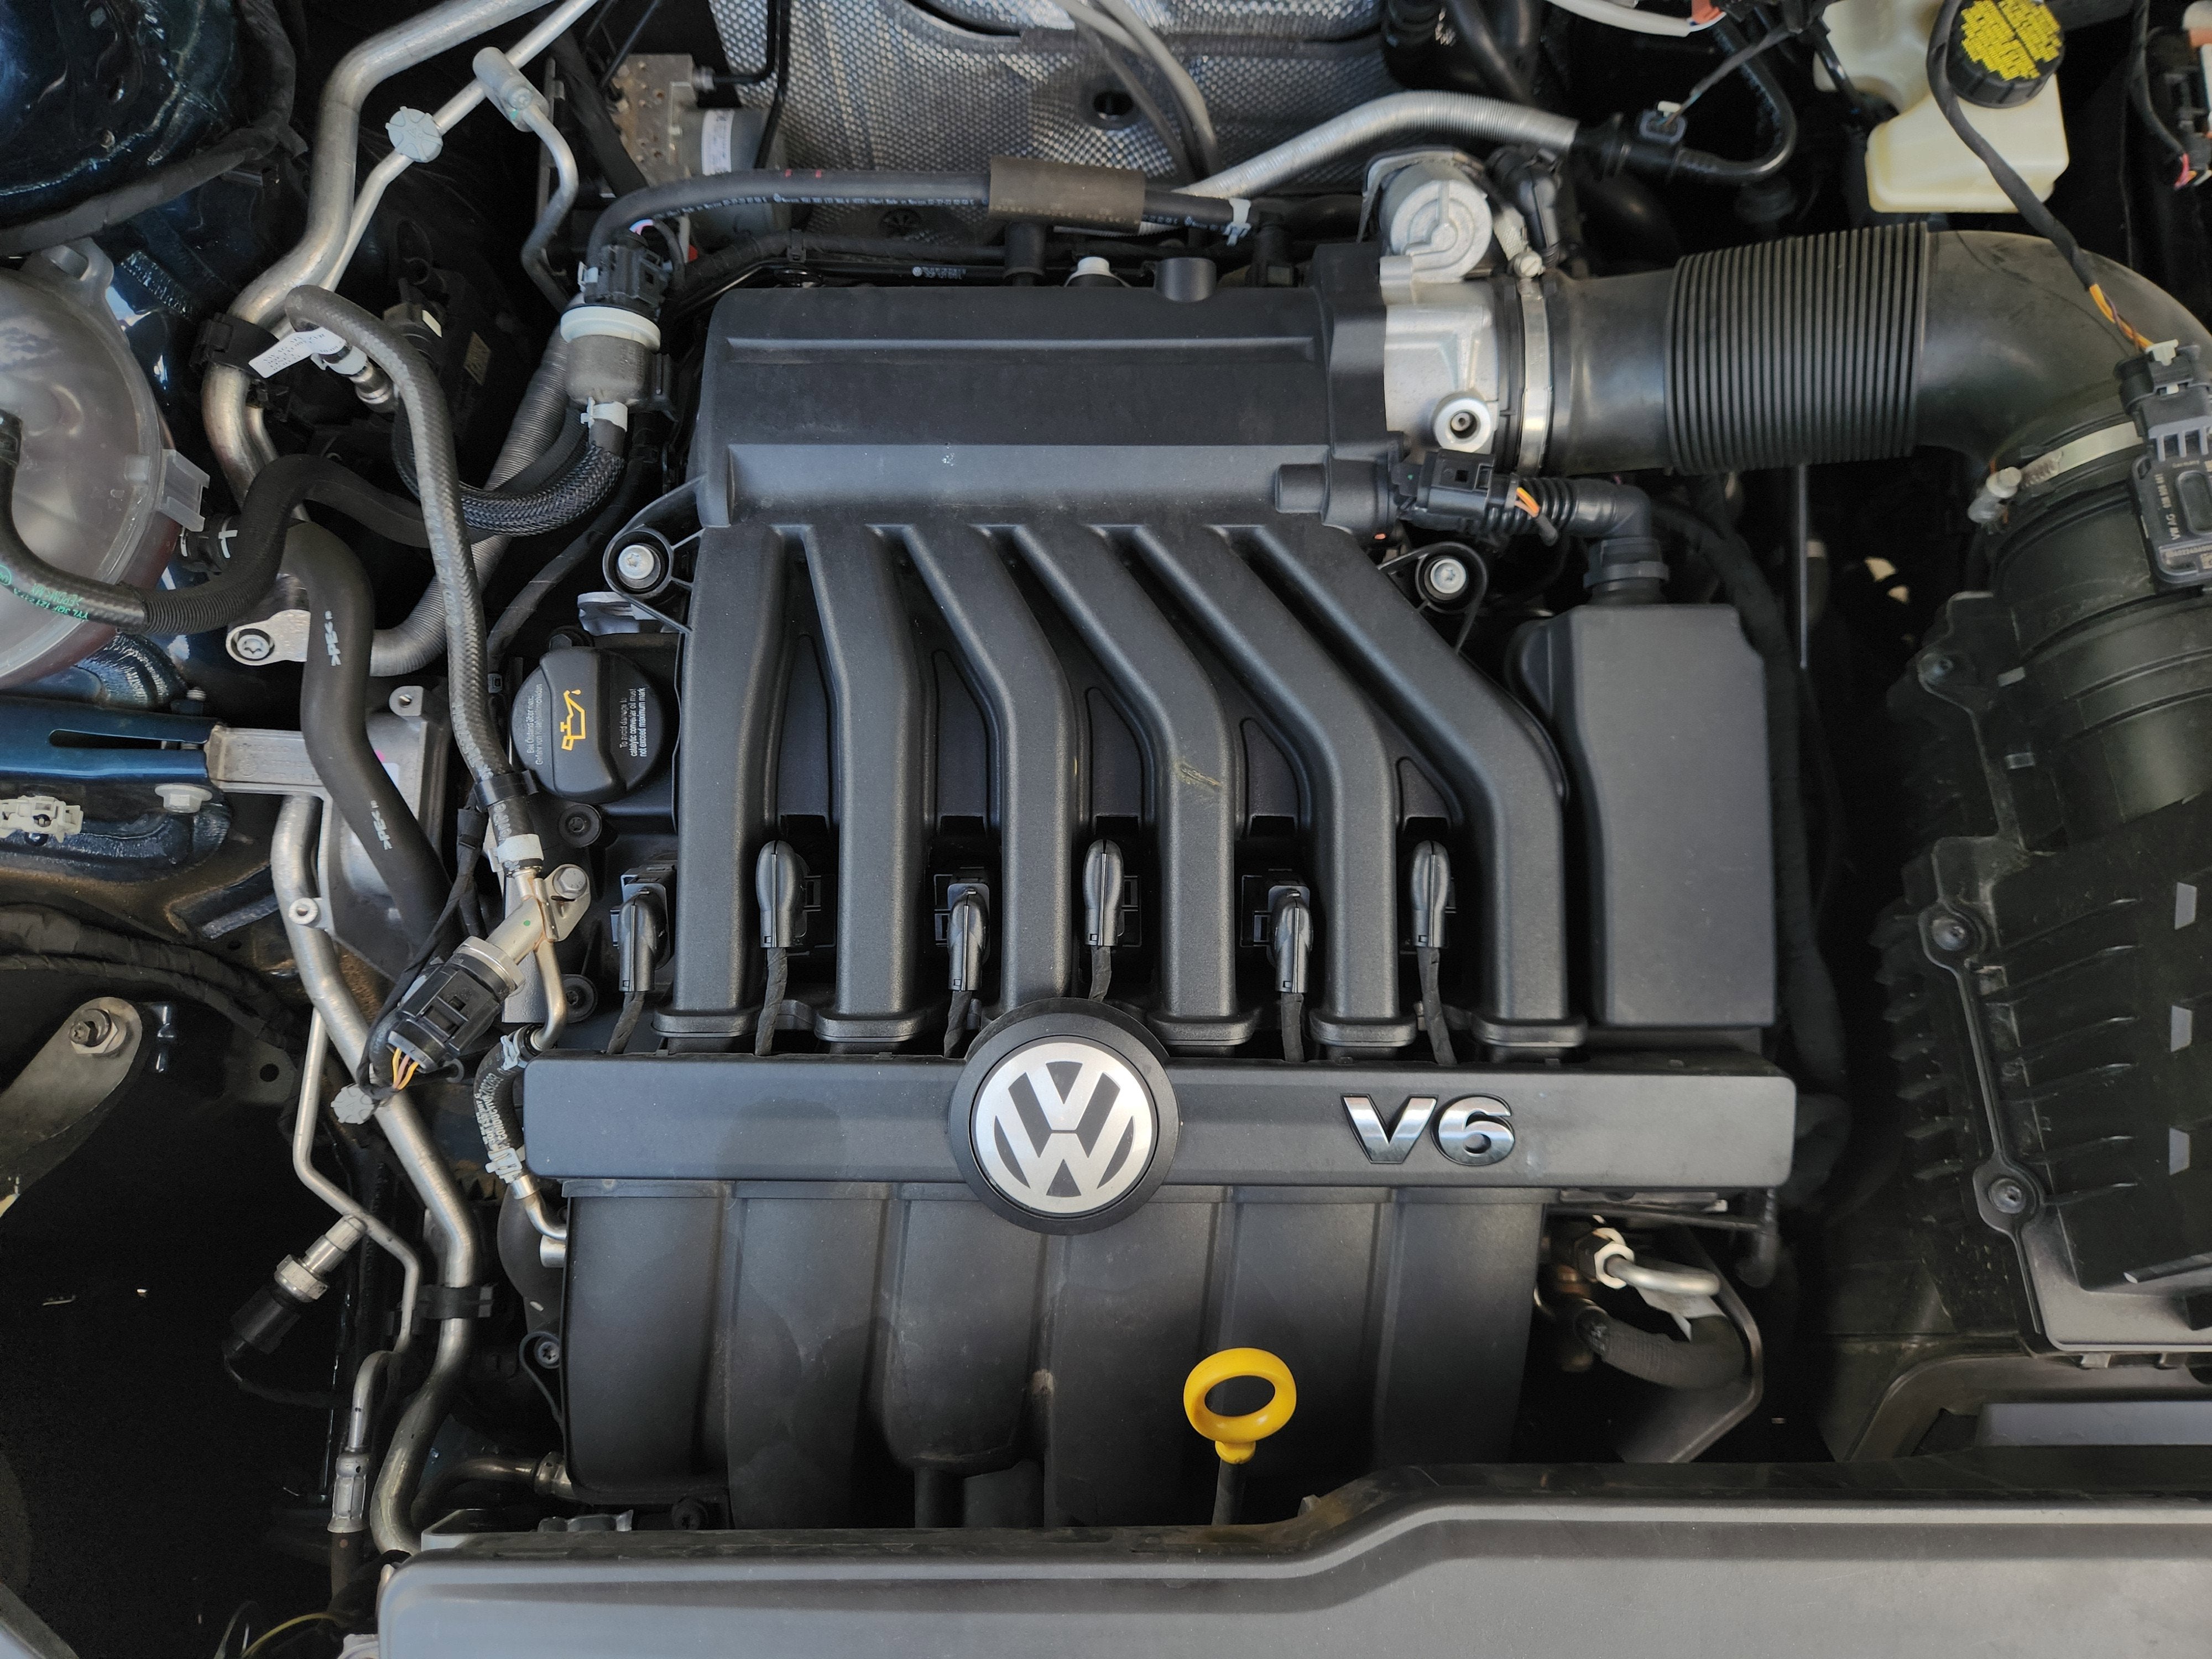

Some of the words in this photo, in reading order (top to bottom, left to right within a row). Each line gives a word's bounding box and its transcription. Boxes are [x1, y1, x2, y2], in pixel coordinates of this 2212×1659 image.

[637, 687, 646, 701] mark
[619, 706, 629, 726] damage
[637, 702, 646, 727] maximum
[619, 726, 628, 740] avoid
[638, 728, 646, 747] exceed
[526, 744, 535, 753] Bei
[535, 745, 544, 765] Gefahr
[629, 735, 639, 757] catalytic
[638, 748, 647, 757] not
[976, 1042, 1152, 1213] VW
[1340, 1093, 1516, 1166] V6
